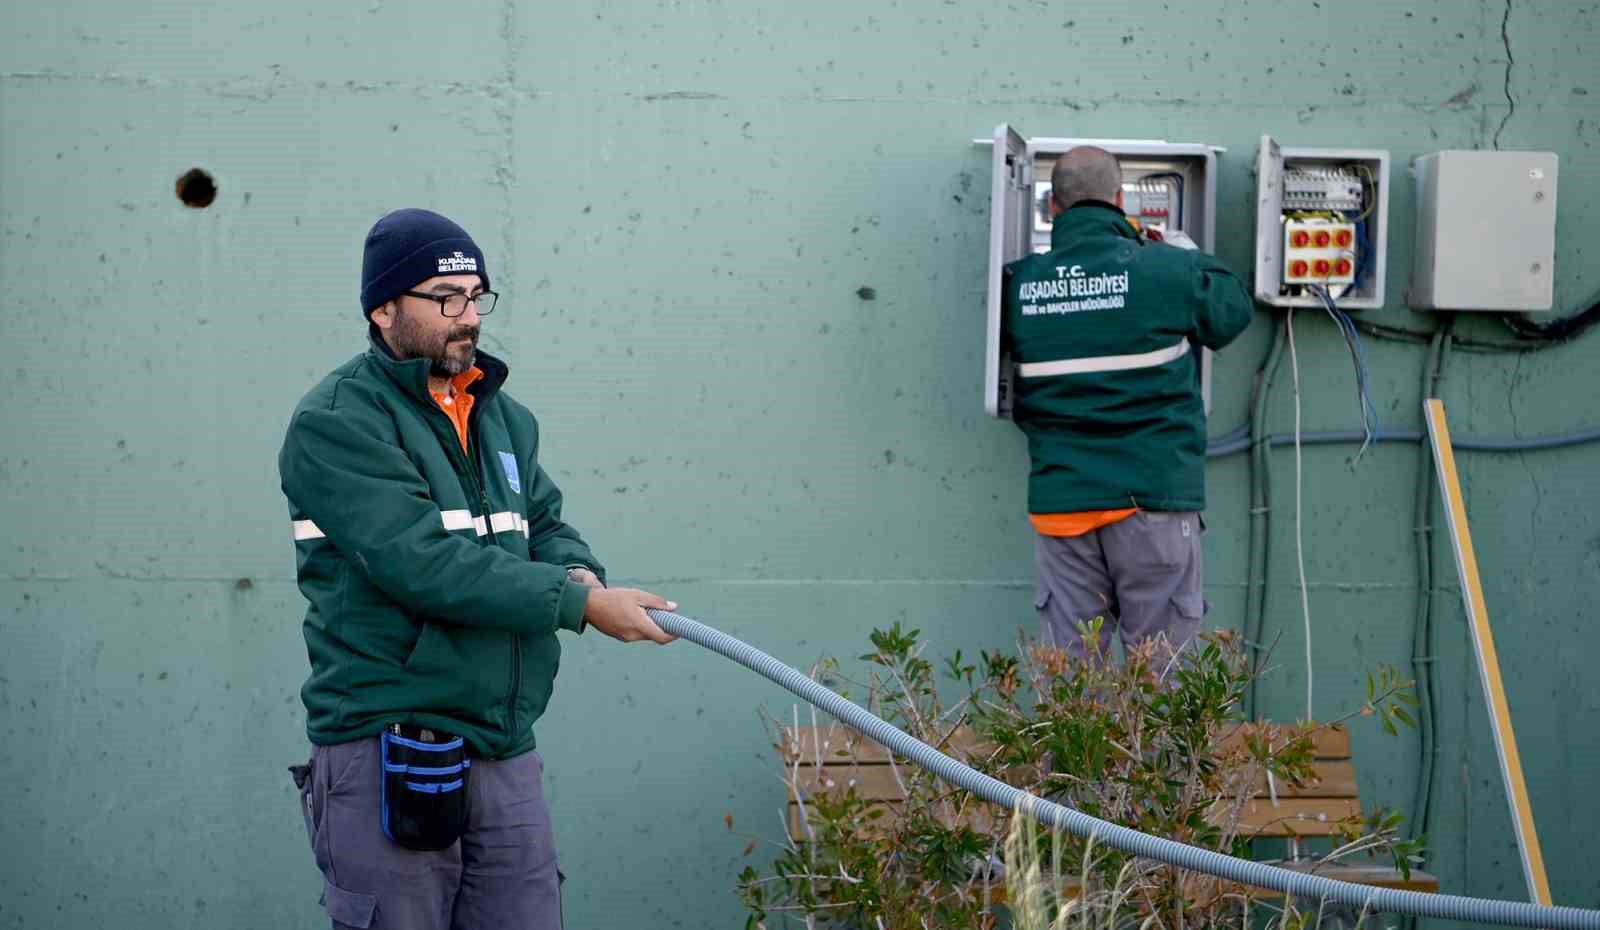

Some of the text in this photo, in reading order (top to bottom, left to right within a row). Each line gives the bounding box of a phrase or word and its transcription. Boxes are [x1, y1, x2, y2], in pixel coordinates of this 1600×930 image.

[1056, 265, 1086, 278] T.C.
[1019, 270, 1128, 303] KUŞADASI BELEDİYESİ
